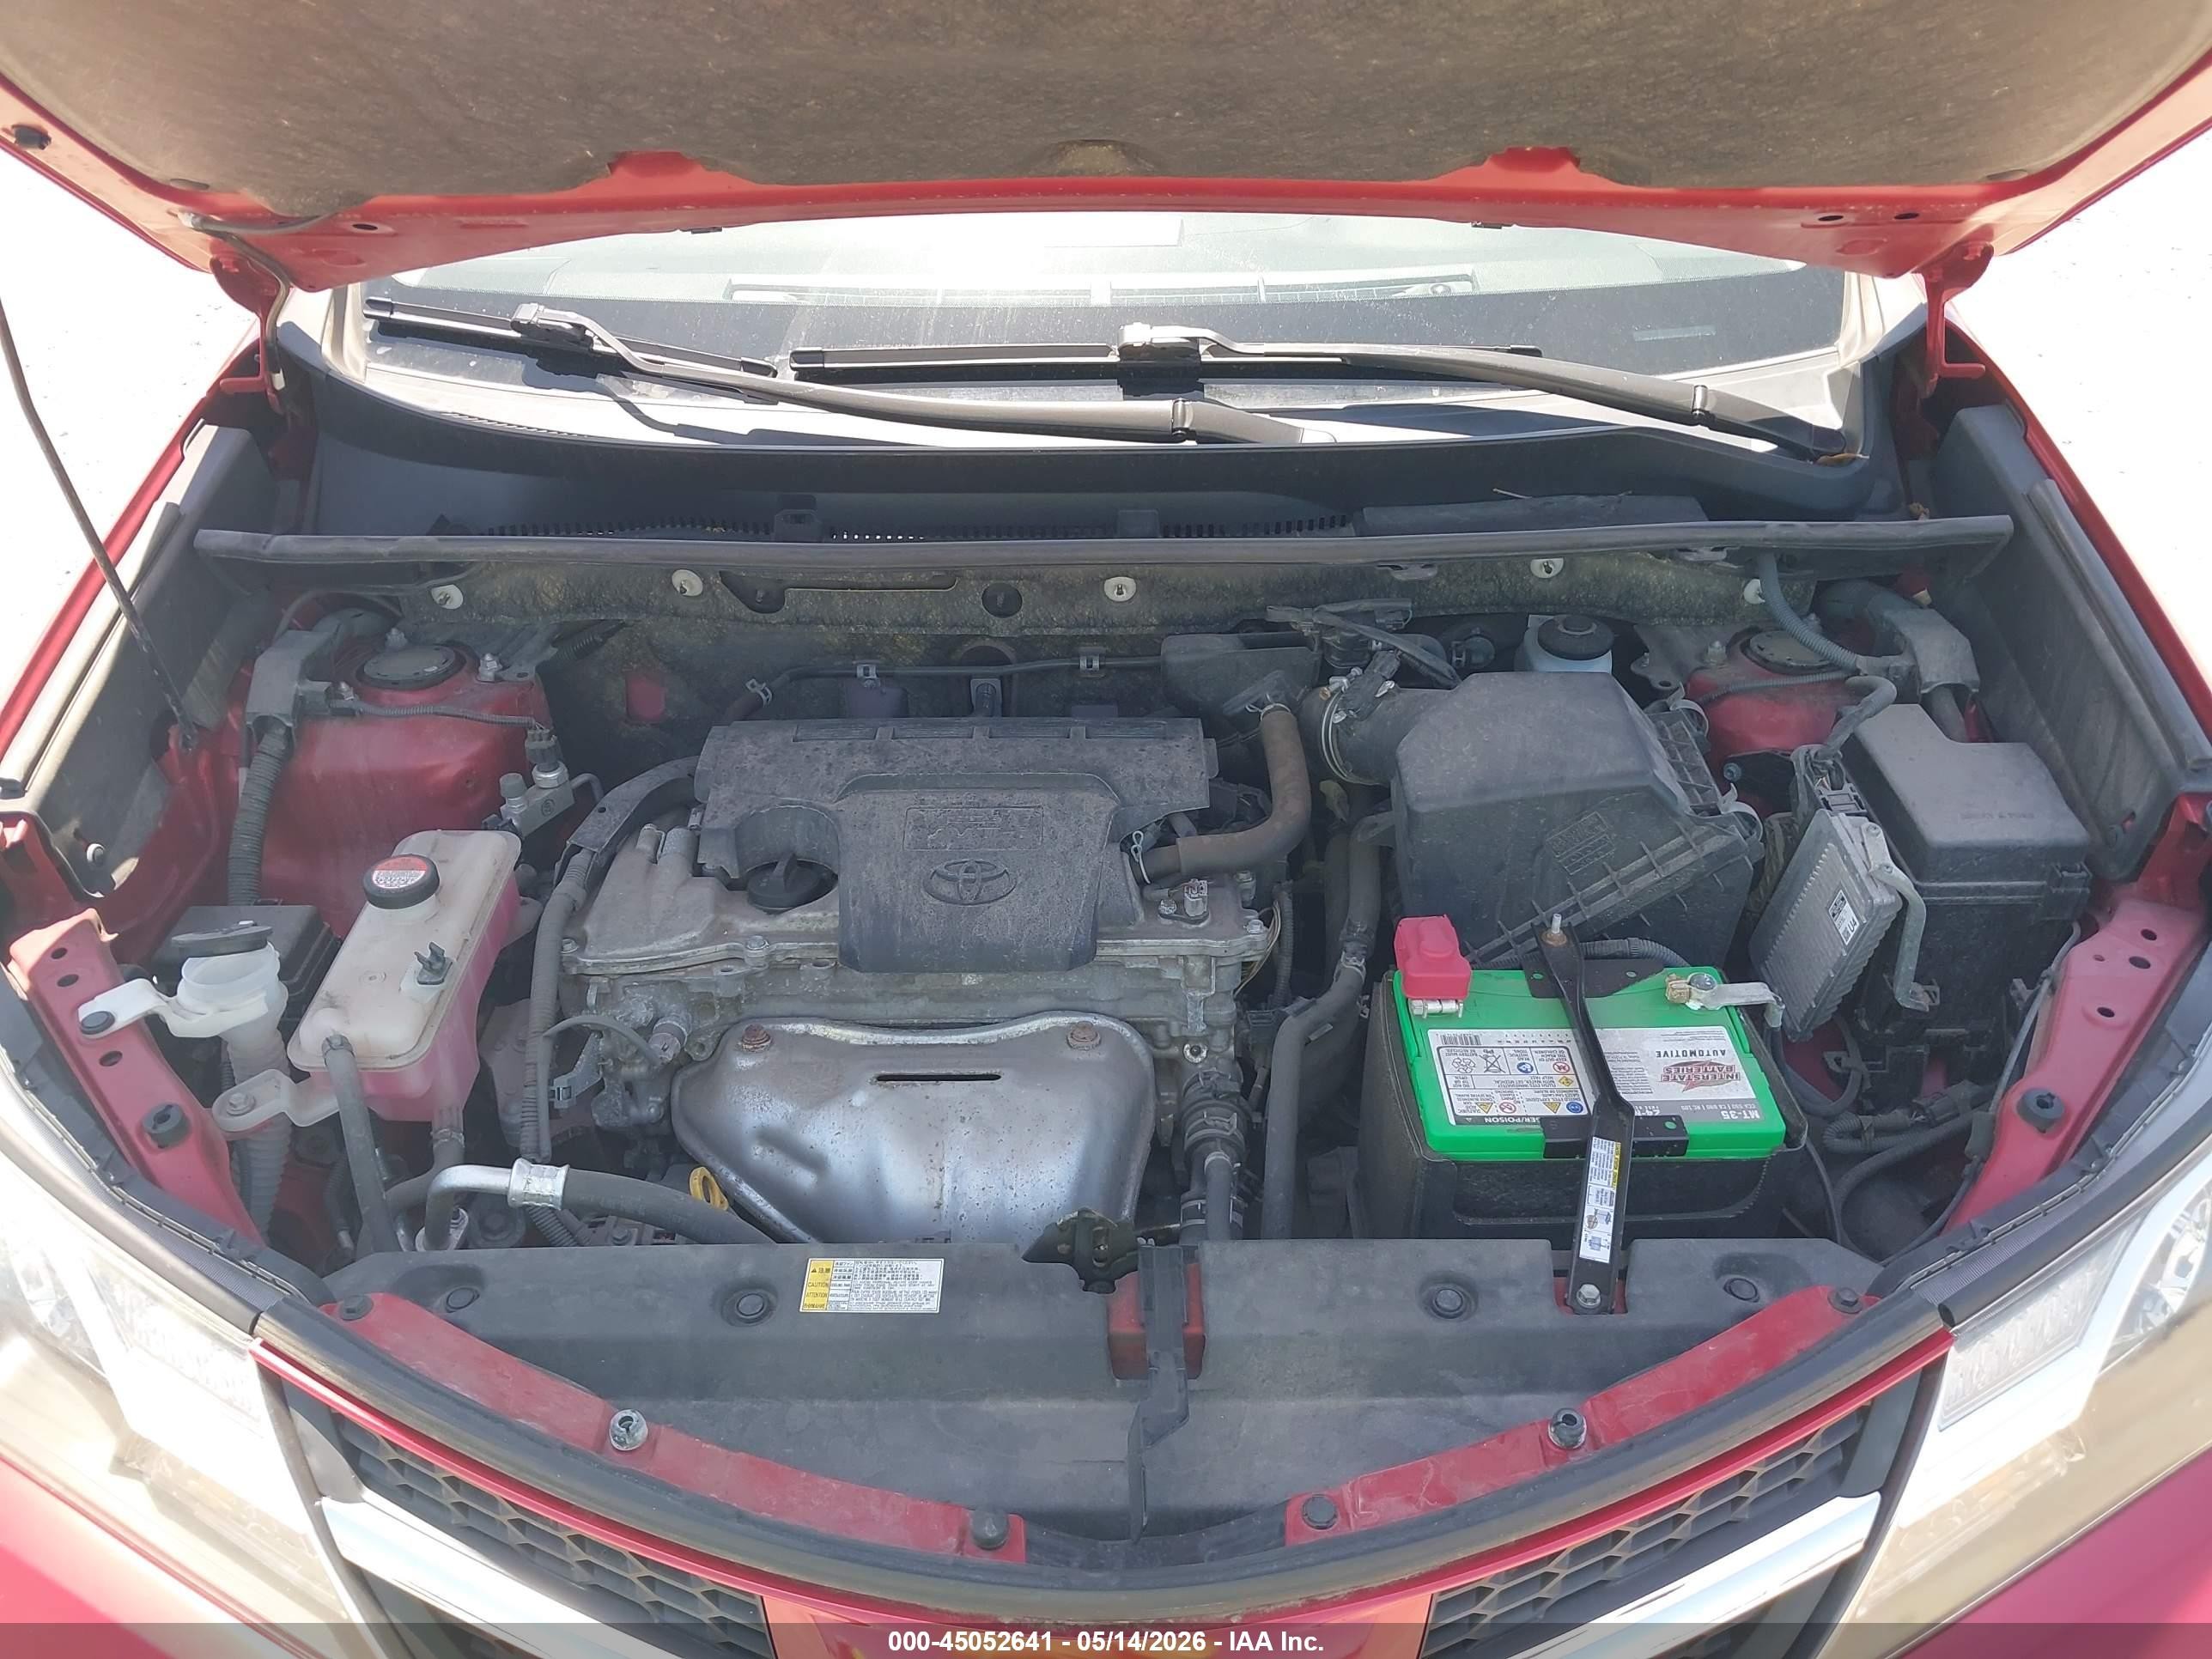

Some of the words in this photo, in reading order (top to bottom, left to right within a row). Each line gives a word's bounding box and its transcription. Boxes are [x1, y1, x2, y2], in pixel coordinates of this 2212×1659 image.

[1656, 1049, 1726, 1058] AUTOMOTIVE
[1662, 1073, 1739, 1082] INTERSTATE
[1720, 1109, 1760, 1120] MT-35
